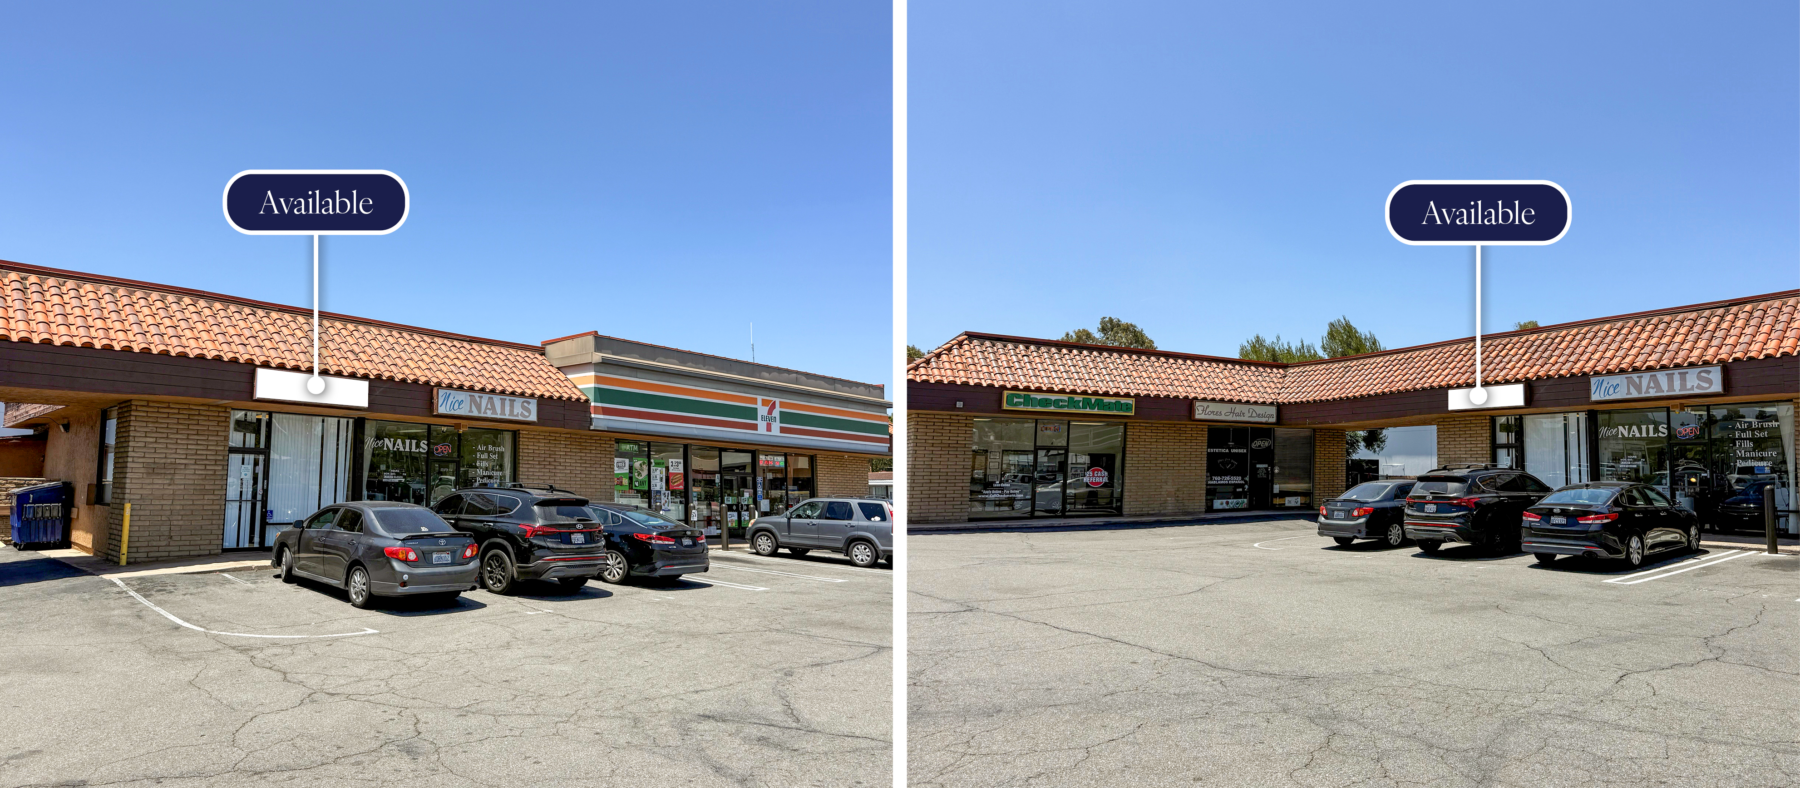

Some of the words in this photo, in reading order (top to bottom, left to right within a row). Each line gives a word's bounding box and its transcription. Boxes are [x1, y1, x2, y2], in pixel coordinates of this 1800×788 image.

[1592, 378, 1621, 398] Nice
[1625, 369, 1714, 396] NAILS
[438, 391, 465, 413] Nice
[468, 394, 532, 419] NAILS
[1006, 393, 1133, 412] CheckMate
[1224, 406, 1245, 418] Hair
[1248, 407, 1275, 421] Design
[1735, 421, 1749, 429] Air
[1752, 420, 1780, 428] Brush
[1599, 426, 1617, 438] Nice
[1618, 424, 1668, 438] NAILS
[1676, 427, 1700, 437] OPEN
[1754, 430, 1768, 438] Set
[365, 437, 384, 450] Nice
[384, 438, 428, 453] NAILS
[433, 445, 452, 453] OPEN
[1735, 440, 1754, 448] Fills
[1736, 459, 1773, 467] Pedicure
